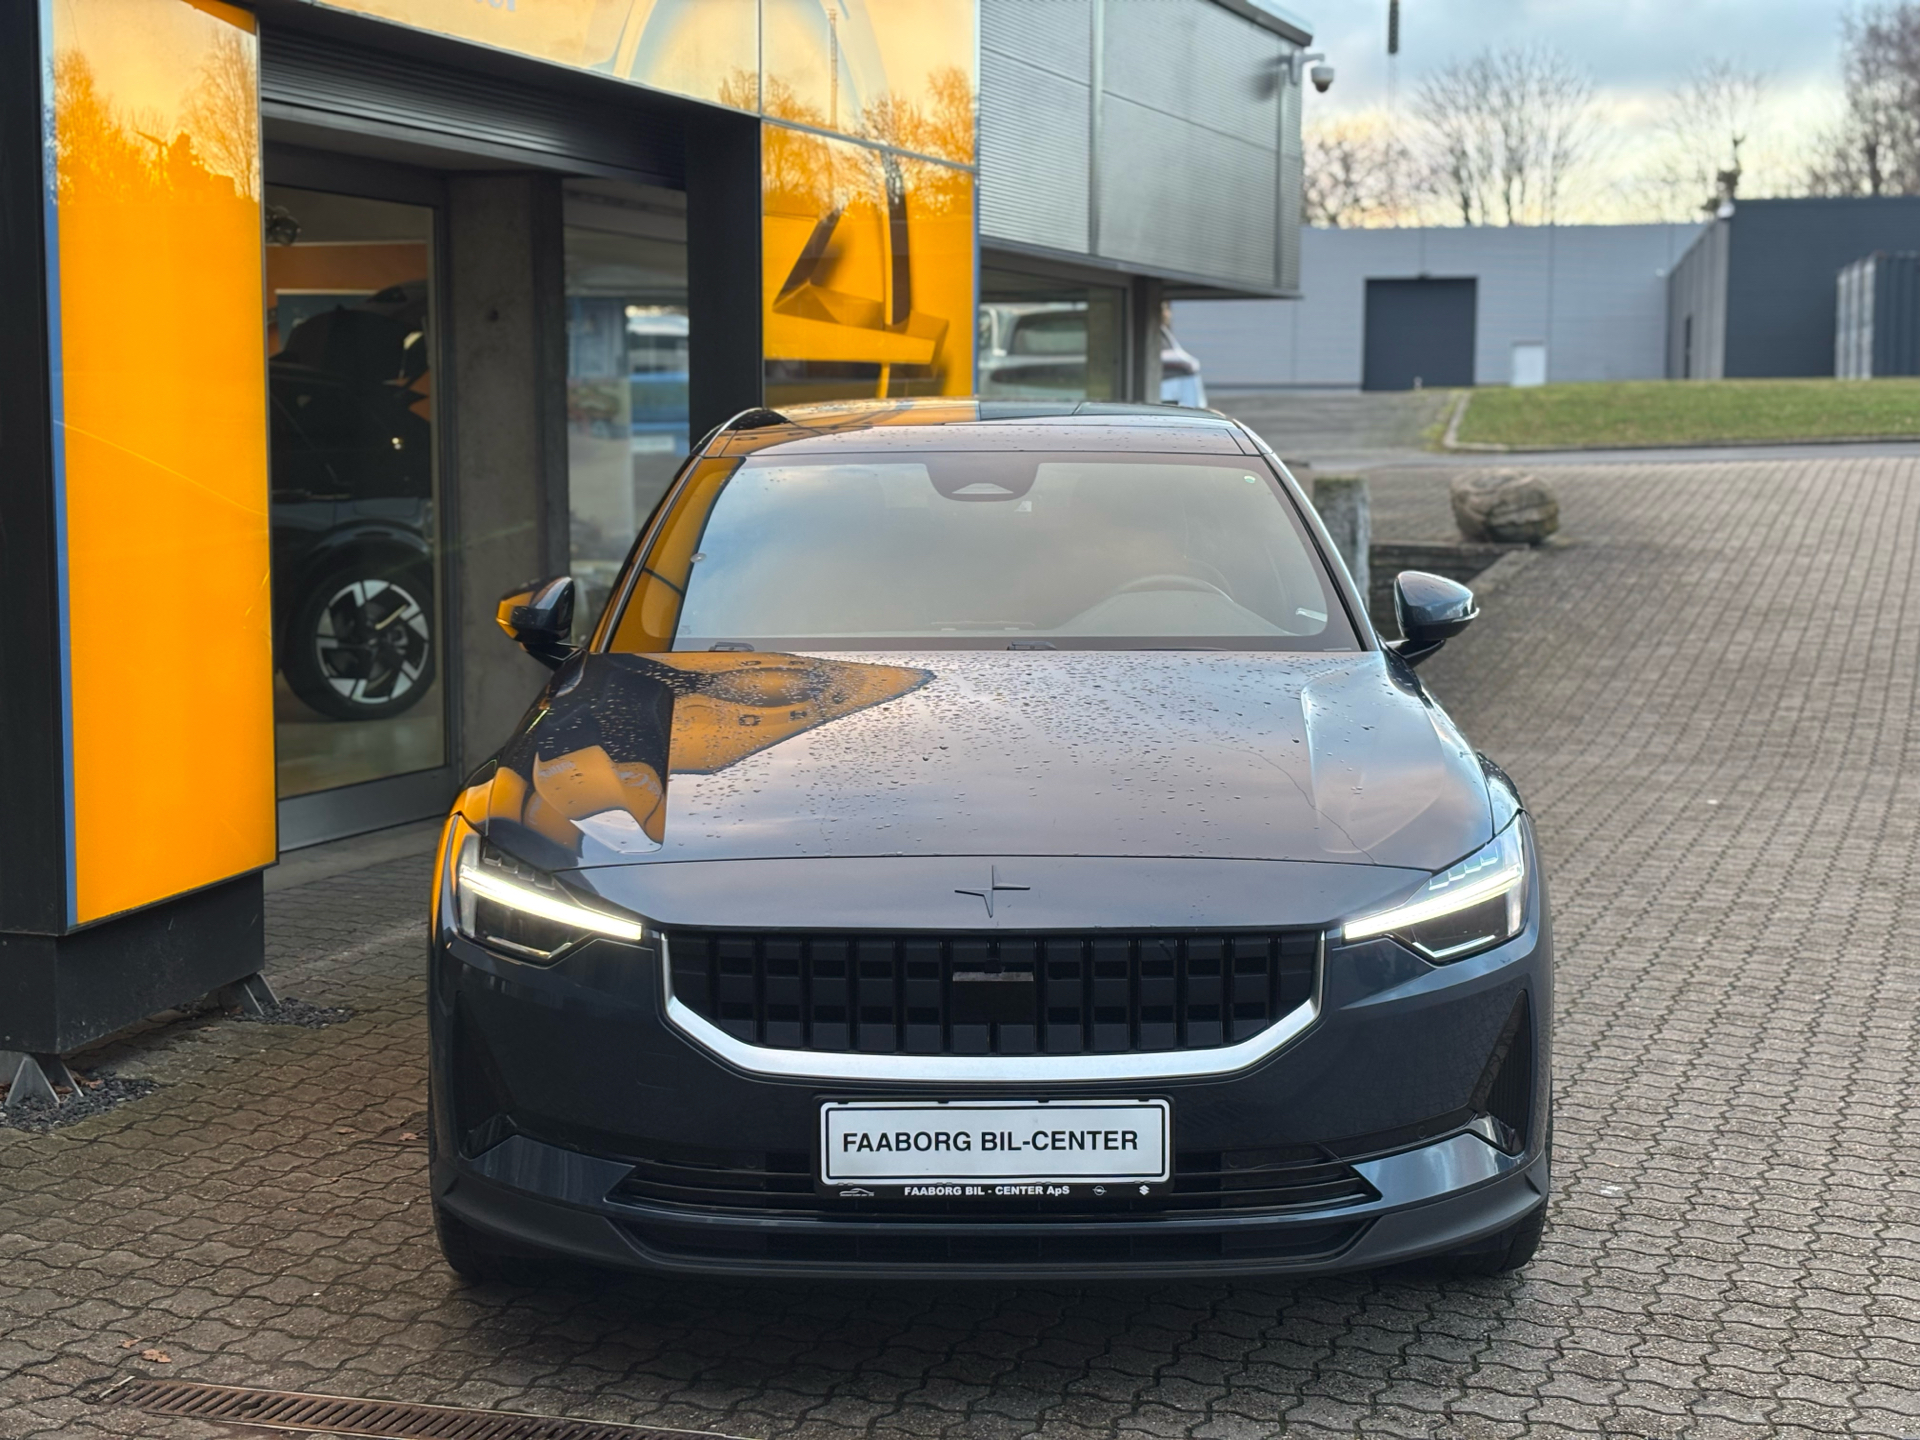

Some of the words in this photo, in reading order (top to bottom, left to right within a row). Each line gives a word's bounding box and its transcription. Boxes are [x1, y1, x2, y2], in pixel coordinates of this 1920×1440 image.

[843, 1131, 972, 1153] FAABORG
[981, 1130, 1139, 1151] BIL-CENTER
[904, 1186, 962, 1196] FAABORG
[965, 1186, 985, 1195] BIL
[995, 1185, 1044, 1195] CENTER
[1046, 1185, 1070, 1197] ApS
